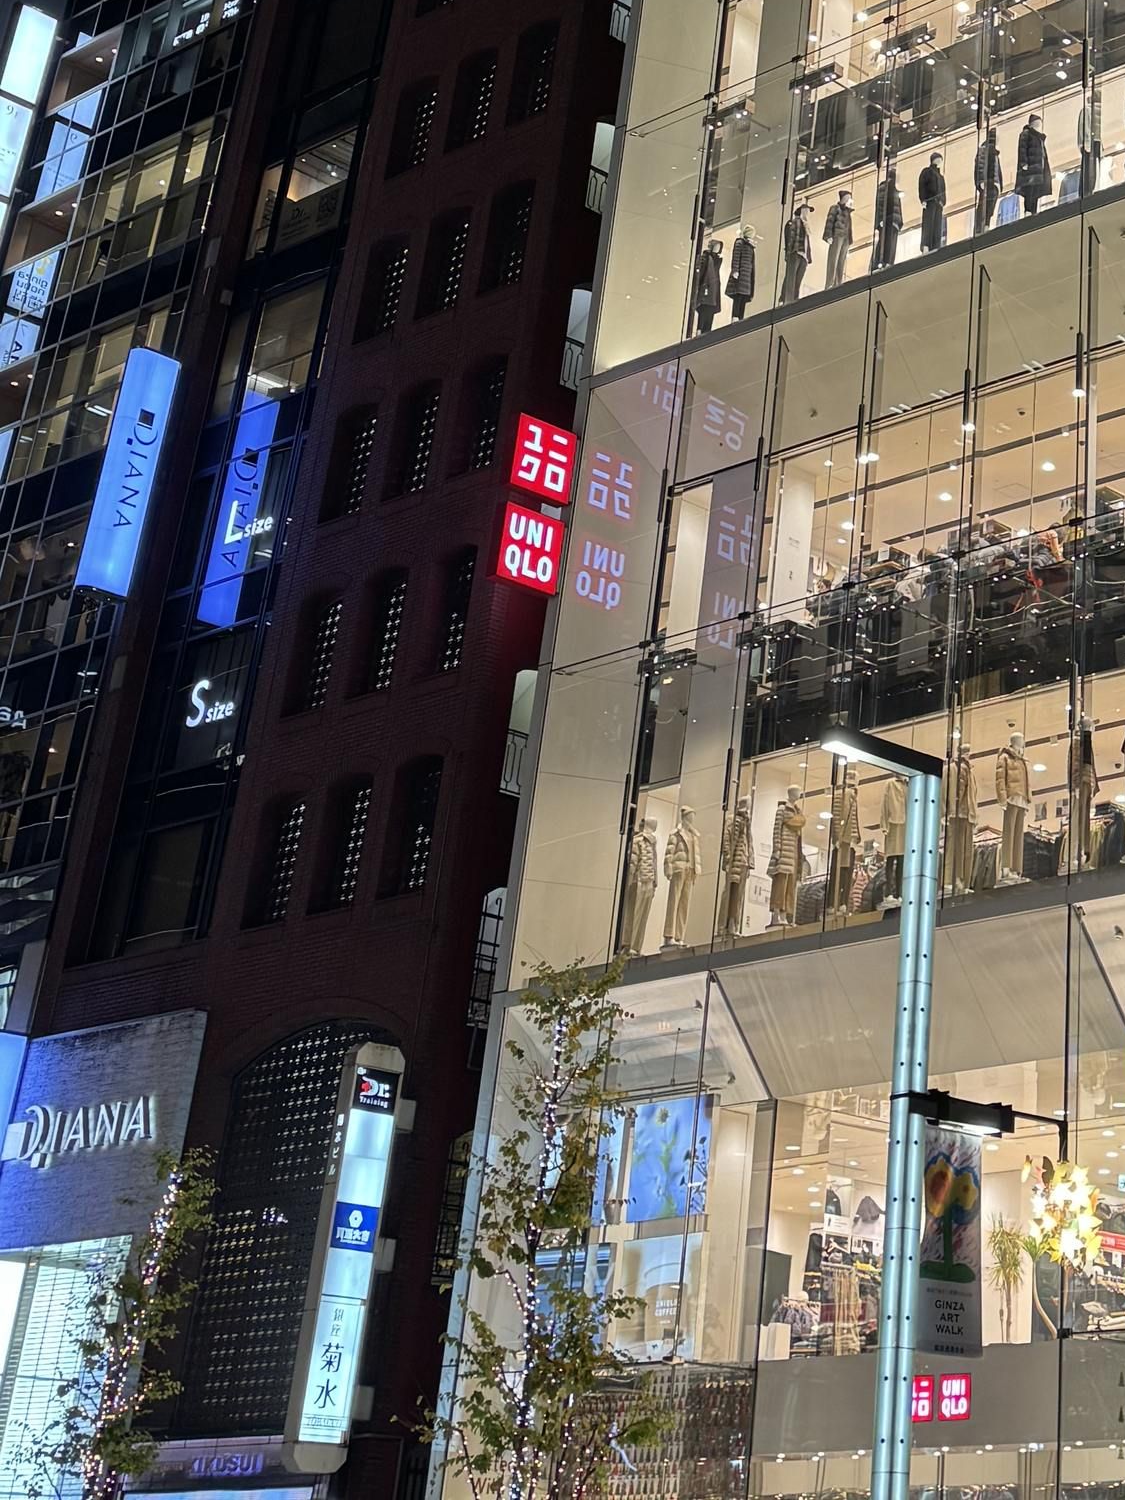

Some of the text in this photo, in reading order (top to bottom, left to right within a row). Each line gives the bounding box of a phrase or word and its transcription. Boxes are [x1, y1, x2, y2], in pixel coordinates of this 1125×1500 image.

[508, 511, 555, 552] UNI
[503, 542, 554, 584] QLO
[359, 1095, 389, 1108] Training
[1, 1095, 153, 1169] DIANA
[935, 1299, 965, 1312] GINZA
[940, 1312, 960, 1324] ART
[935, 1324, 964, 1336] WALK
[313, 1342, 345, 1410] 菊水
[942, 1378, 967, 1398] UNI
[941, 1396, 968, 1418] QLO
